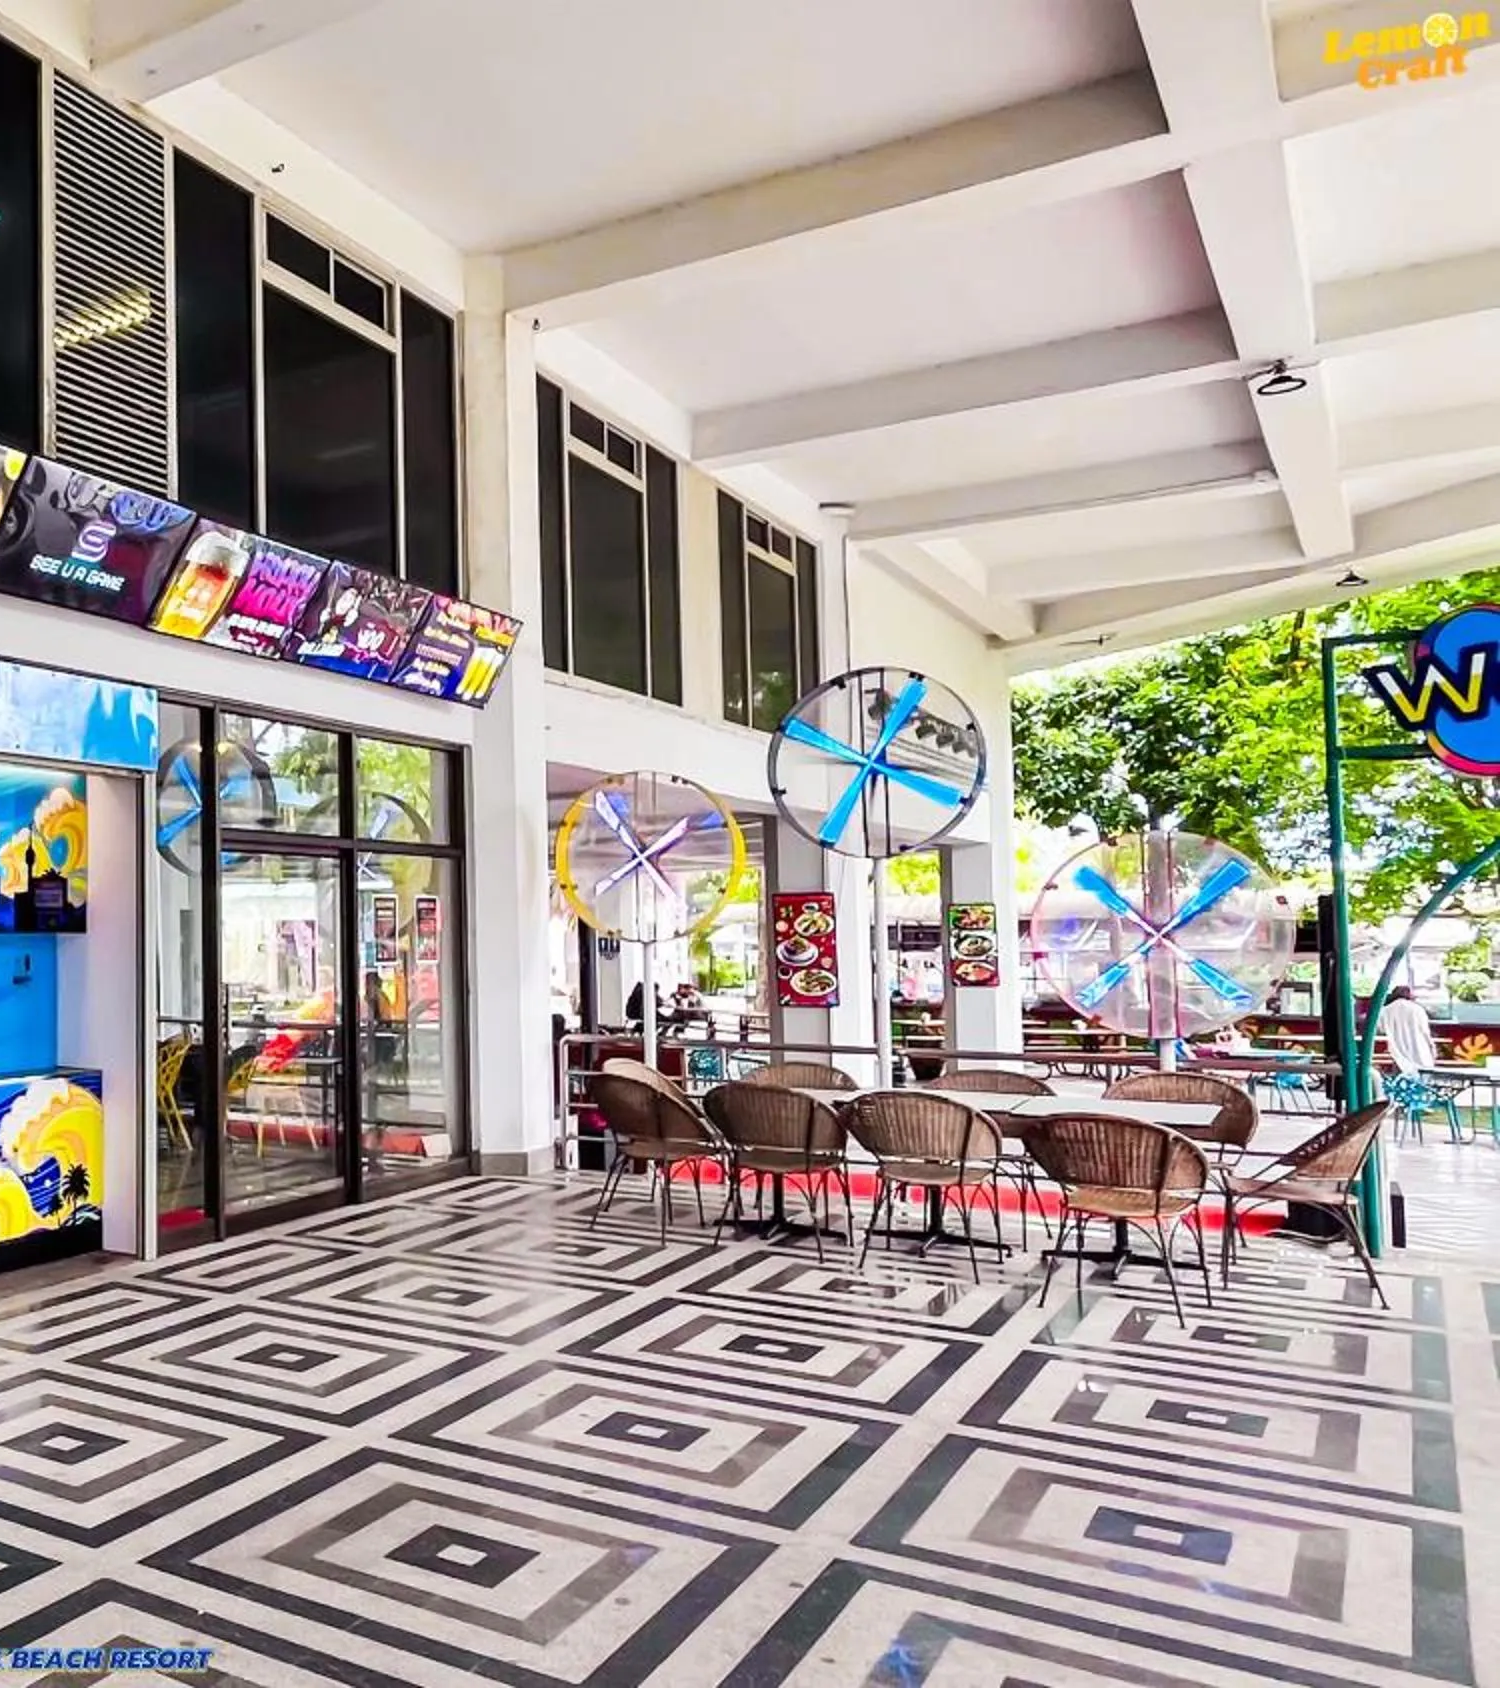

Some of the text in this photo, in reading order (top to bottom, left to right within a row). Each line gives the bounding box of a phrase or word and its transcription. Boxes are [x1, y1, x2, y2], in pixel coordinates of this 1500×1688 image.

[61, 562, 77, 578] U
[72, 565, 88, 581] A
[85, 569, 125, 592] GAME
